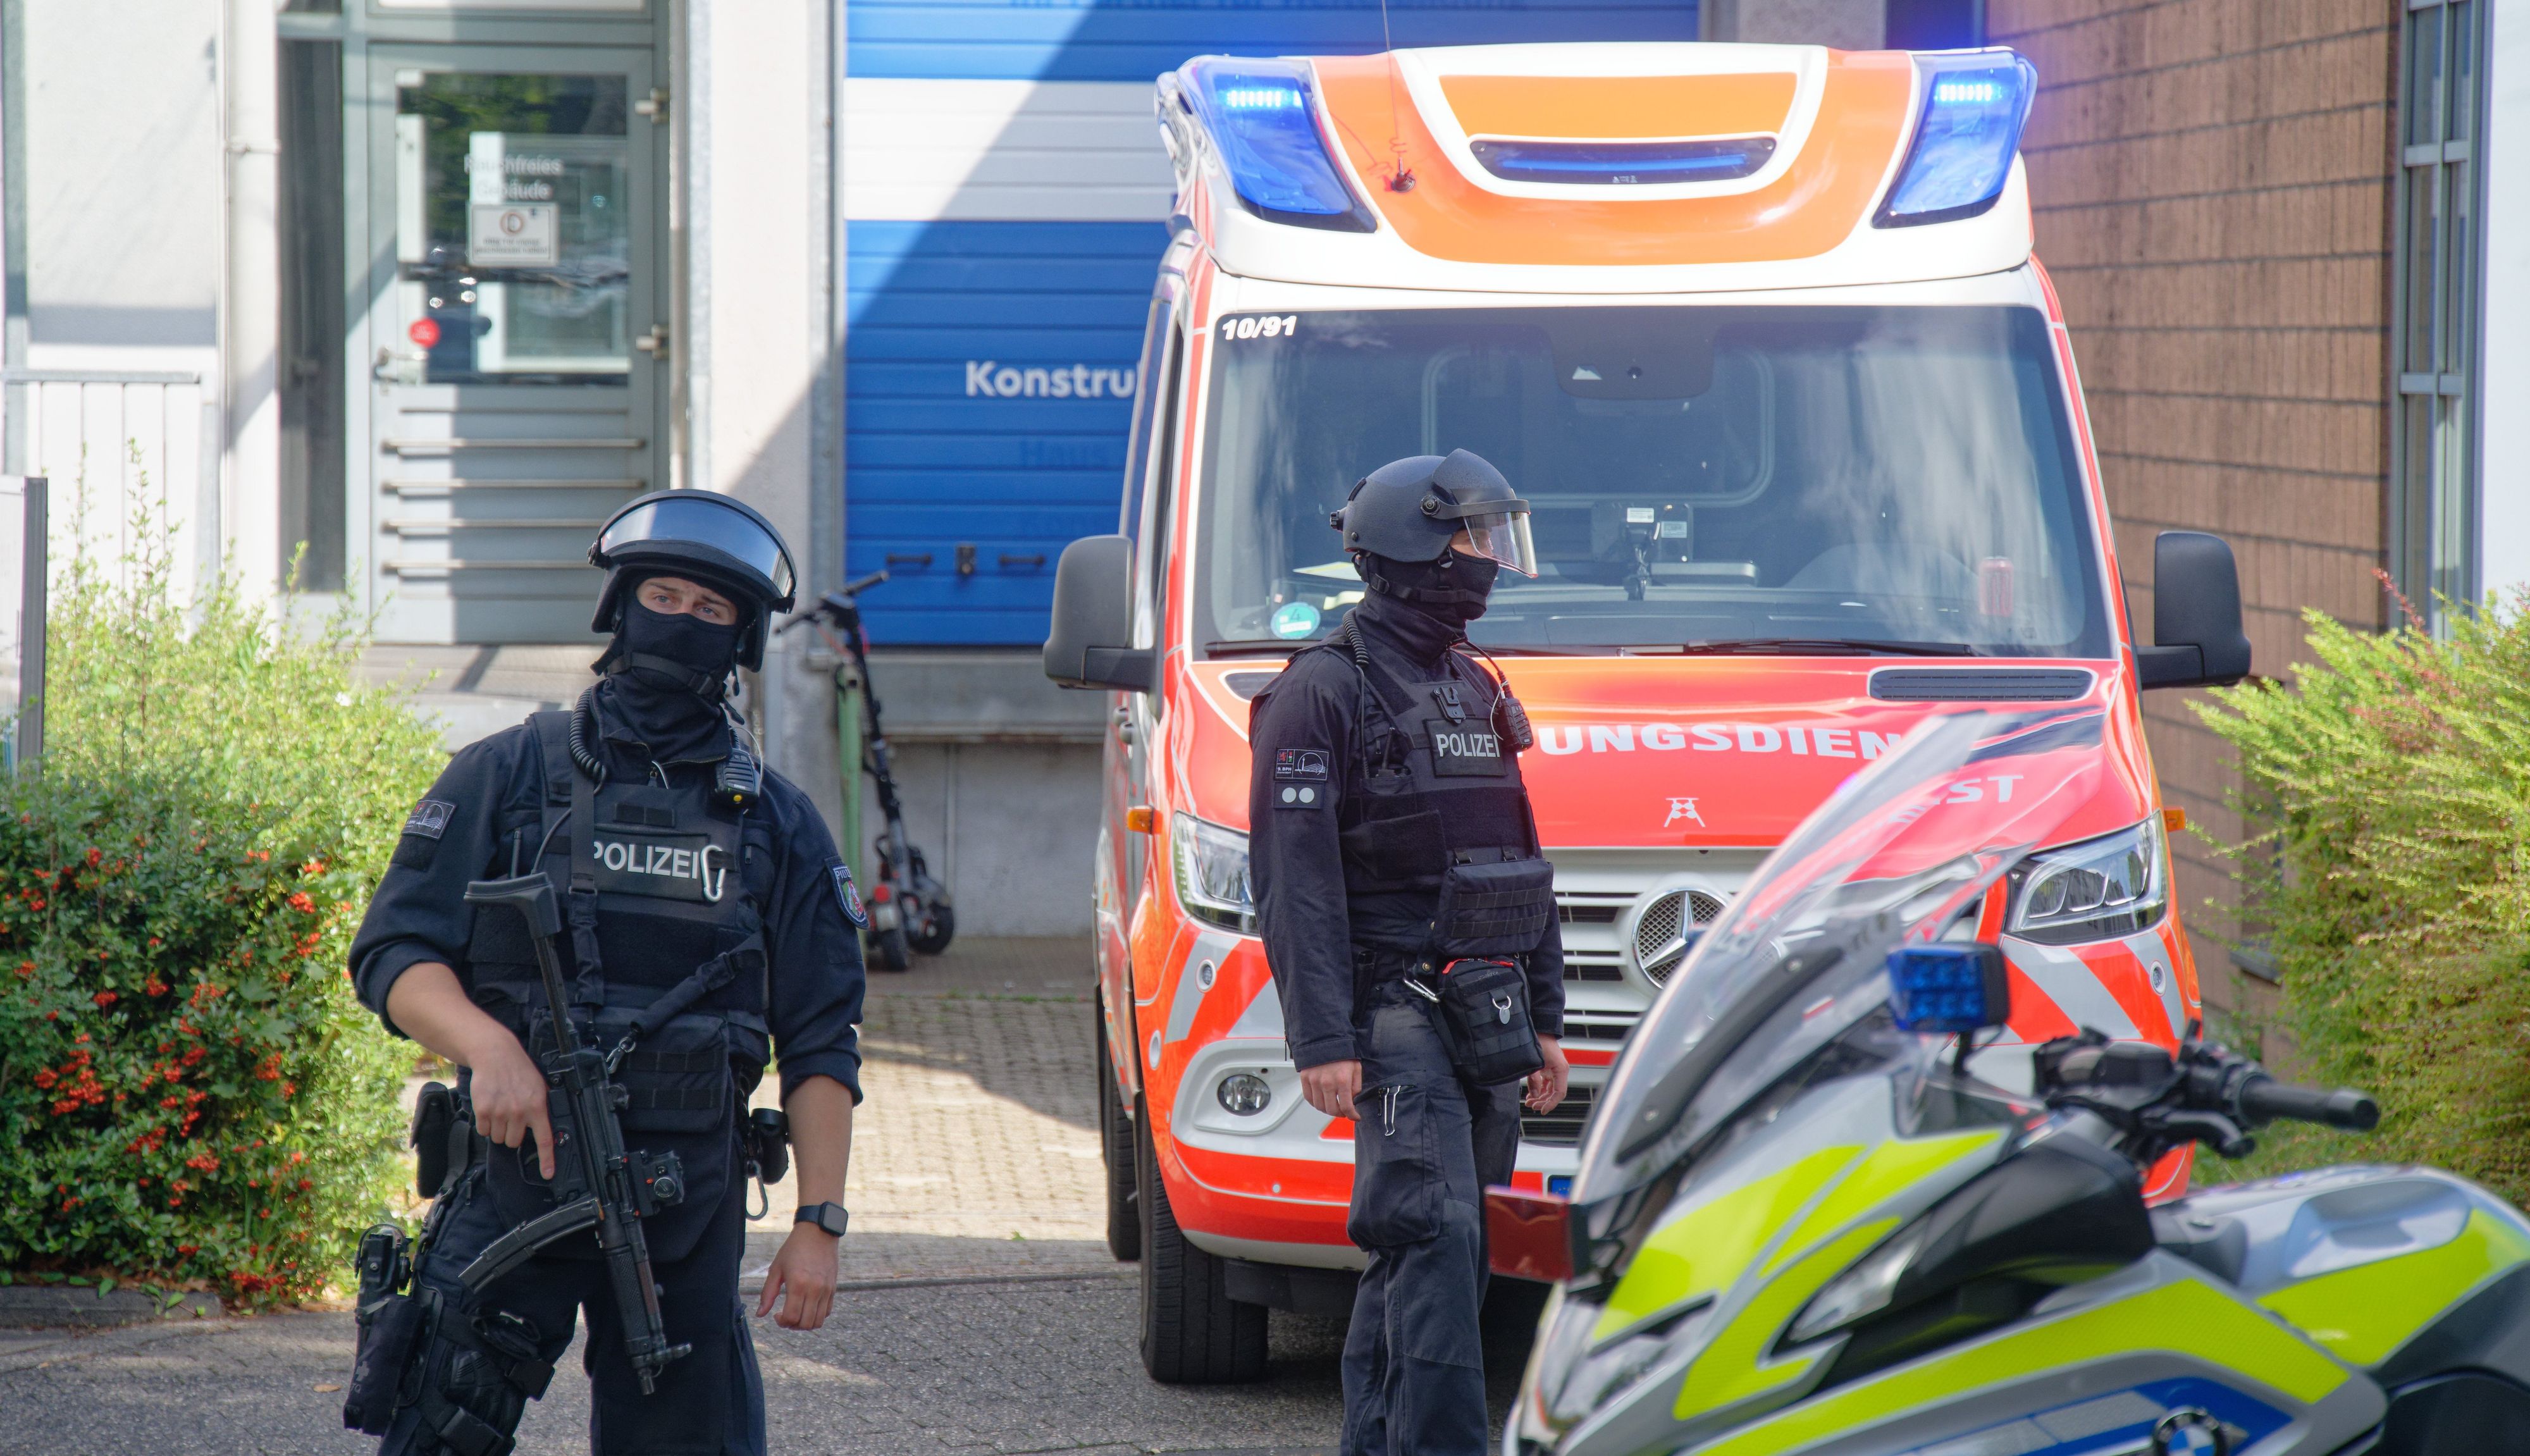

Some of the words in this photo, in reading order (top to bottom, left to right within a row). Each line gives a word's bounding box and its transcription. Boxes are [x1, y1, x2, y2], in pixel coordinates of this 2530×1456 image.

[1223, 316, 1297, 340] 10/91
[966, 360, 1140, 398] Konstru
[1436, 733, 1500, 758] POLIZEI
[1516, 723, 1901, 760] UNGSDIEN
